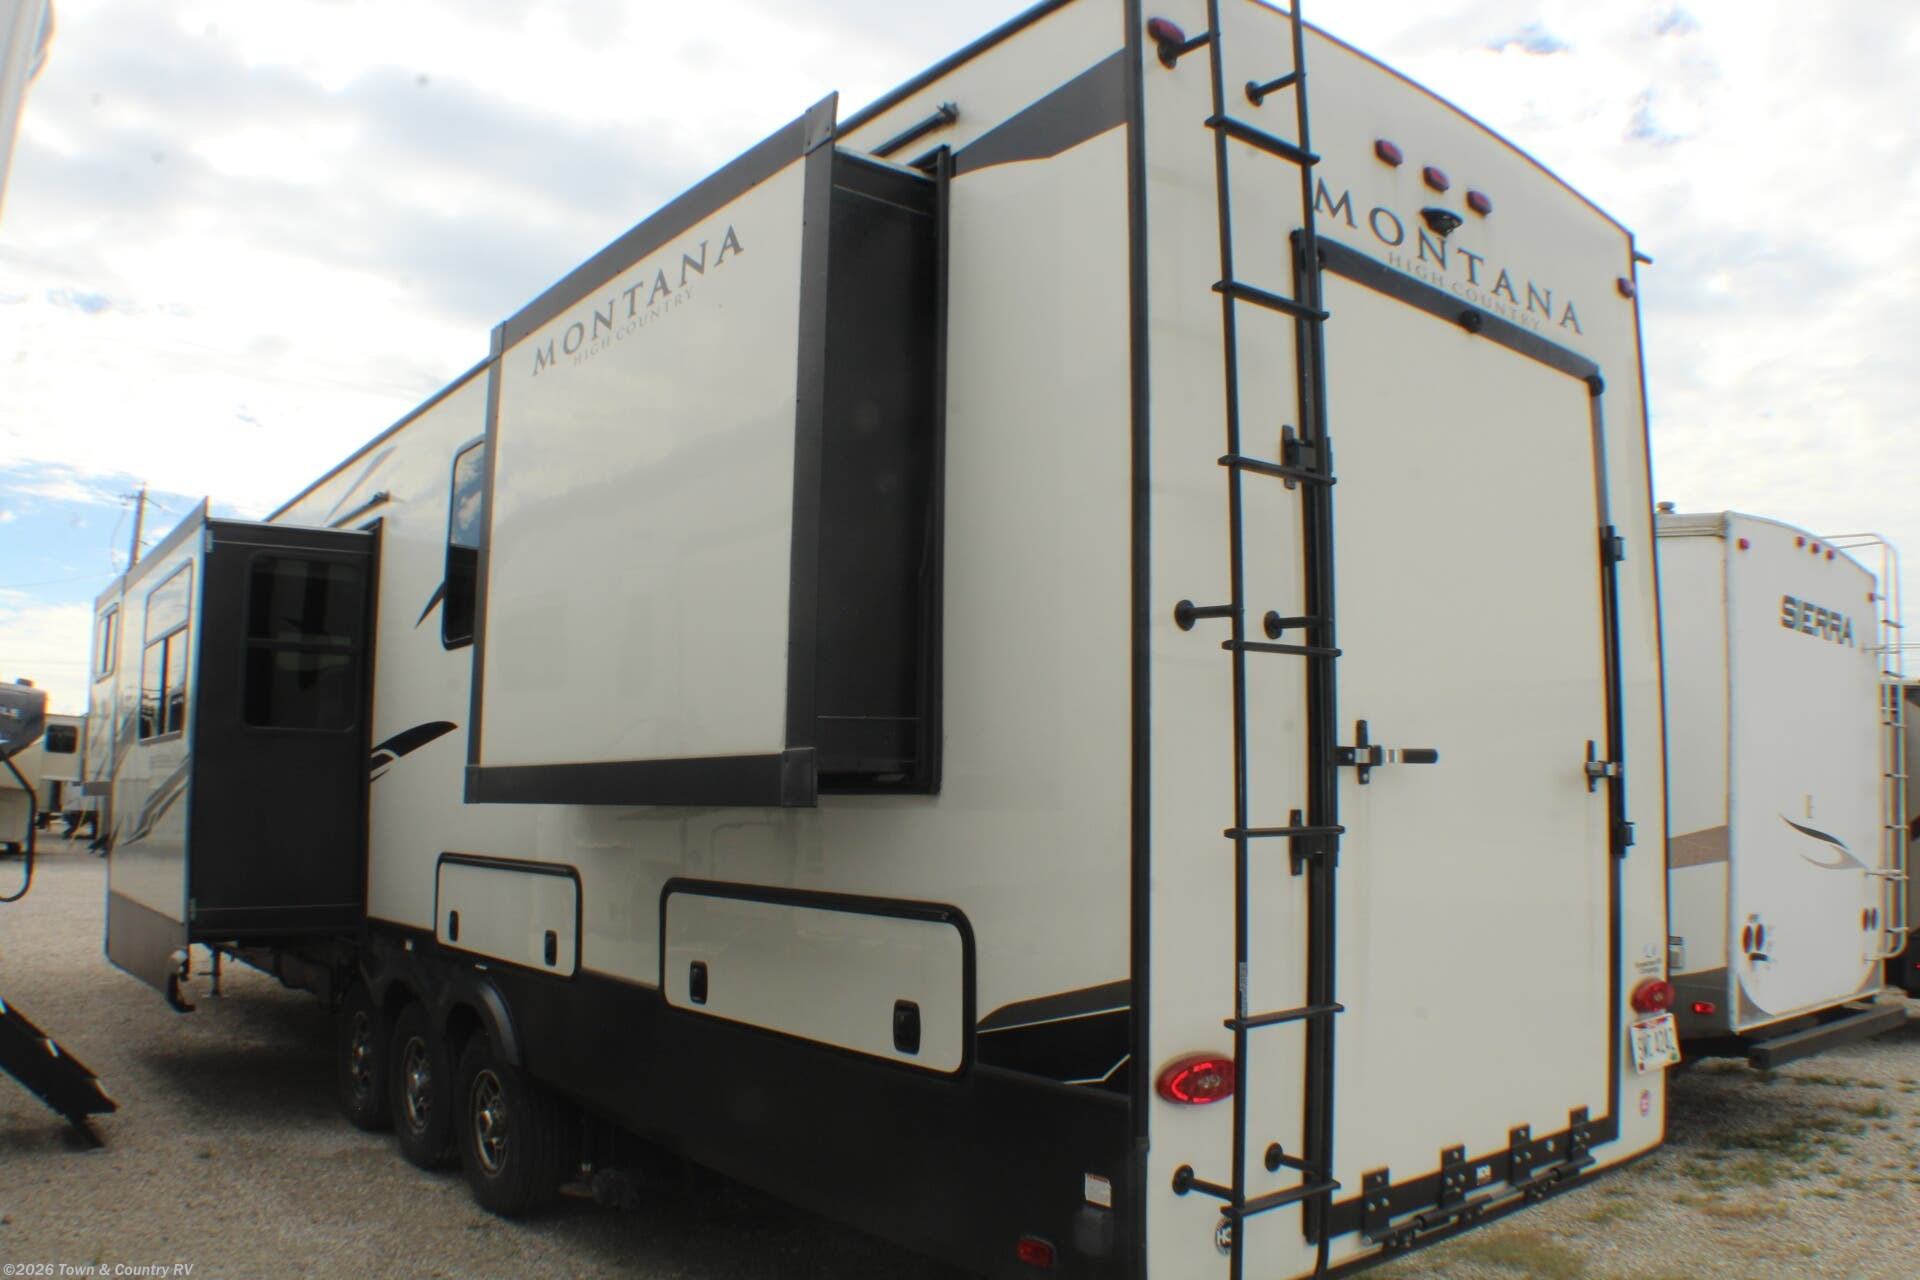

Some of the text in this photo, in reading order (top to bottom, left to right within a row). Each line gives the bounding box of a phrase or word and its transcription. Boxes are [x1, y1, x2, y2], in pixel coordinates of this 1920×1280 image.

[1313, 176, 1584, 336] MONTANA
[1387, 250, 1541, 331] HIGH COUNTRY
[531, 223, 745, 377] MONTANA
[573, 285, 693, 366] HIGH COUNTRY
[1780, 593, 1855, 649] SIERRA
